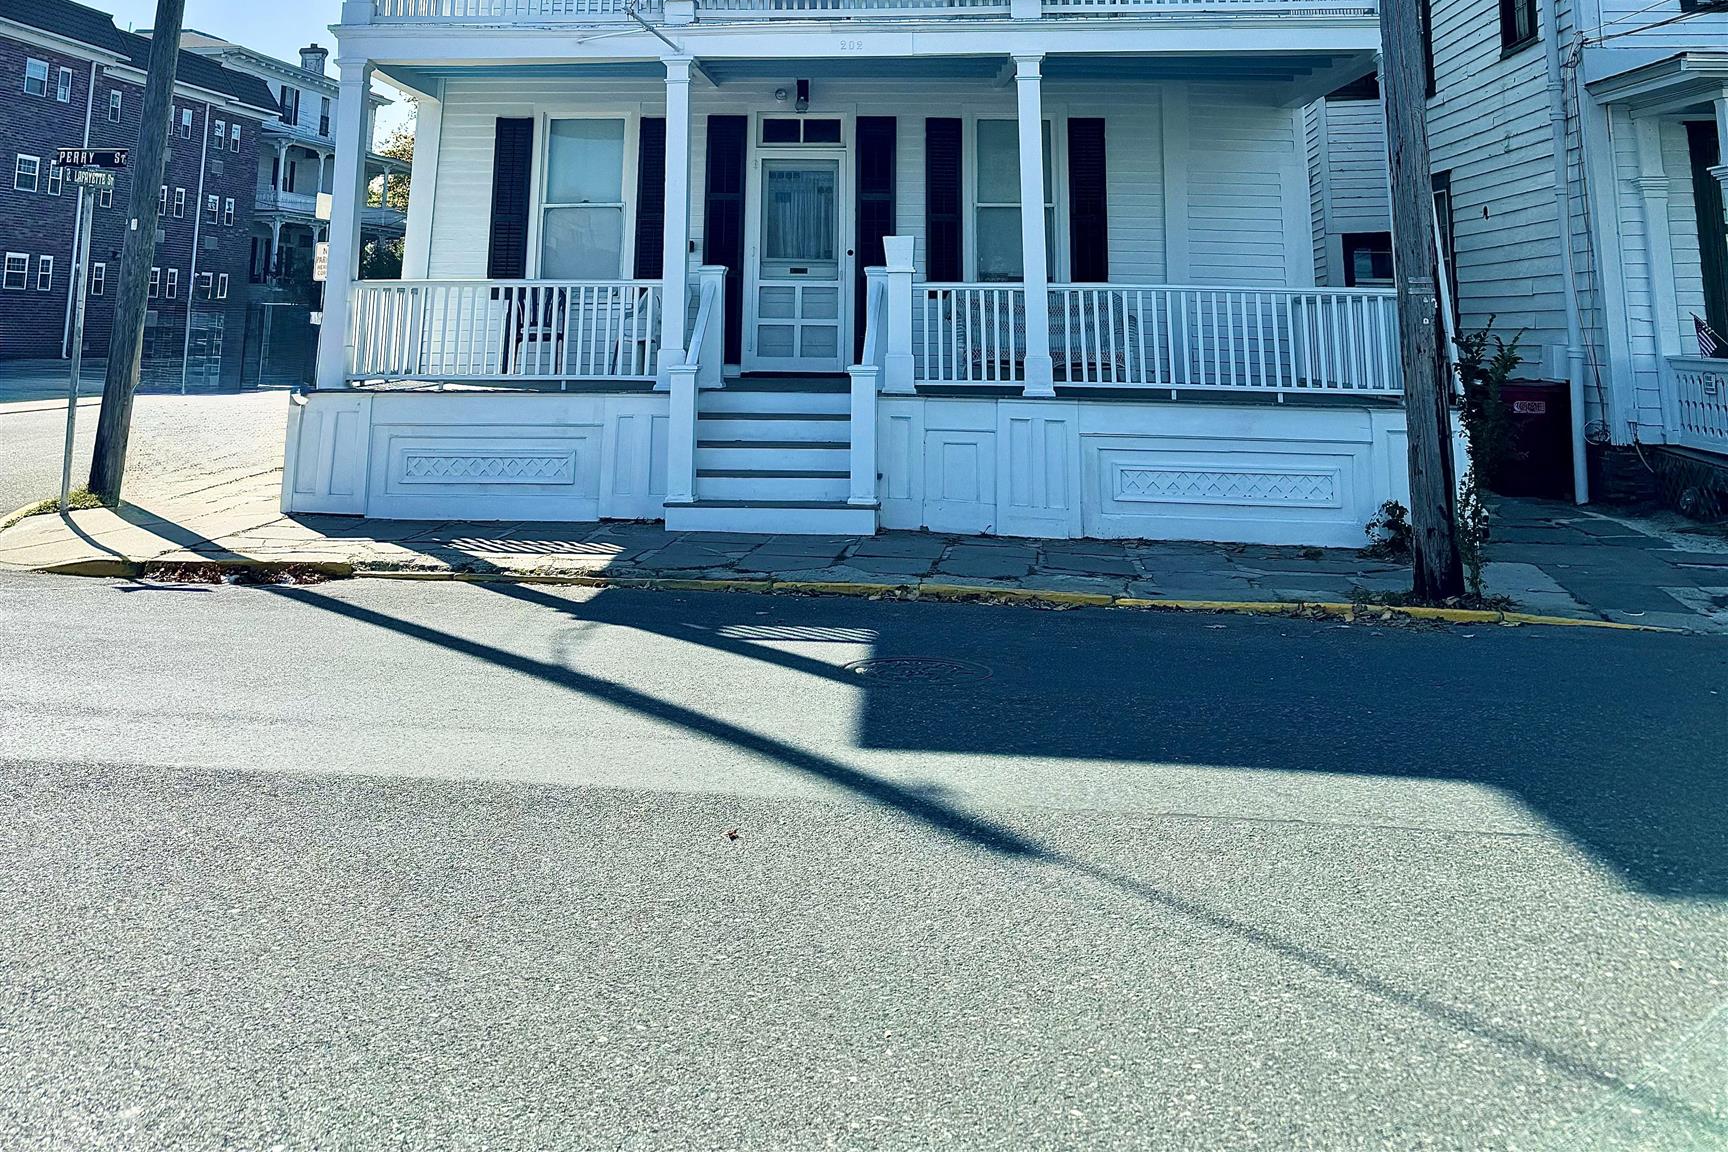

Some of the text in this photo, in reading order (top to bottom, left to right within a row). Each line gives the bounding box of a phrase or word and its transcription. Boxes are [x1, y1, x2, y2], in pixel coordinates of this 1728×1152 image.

[840, 39, 863, 50] 202
[59, 151, 95, 165] PERRY
[74, 170, 106, 185] LAFAYETTE
